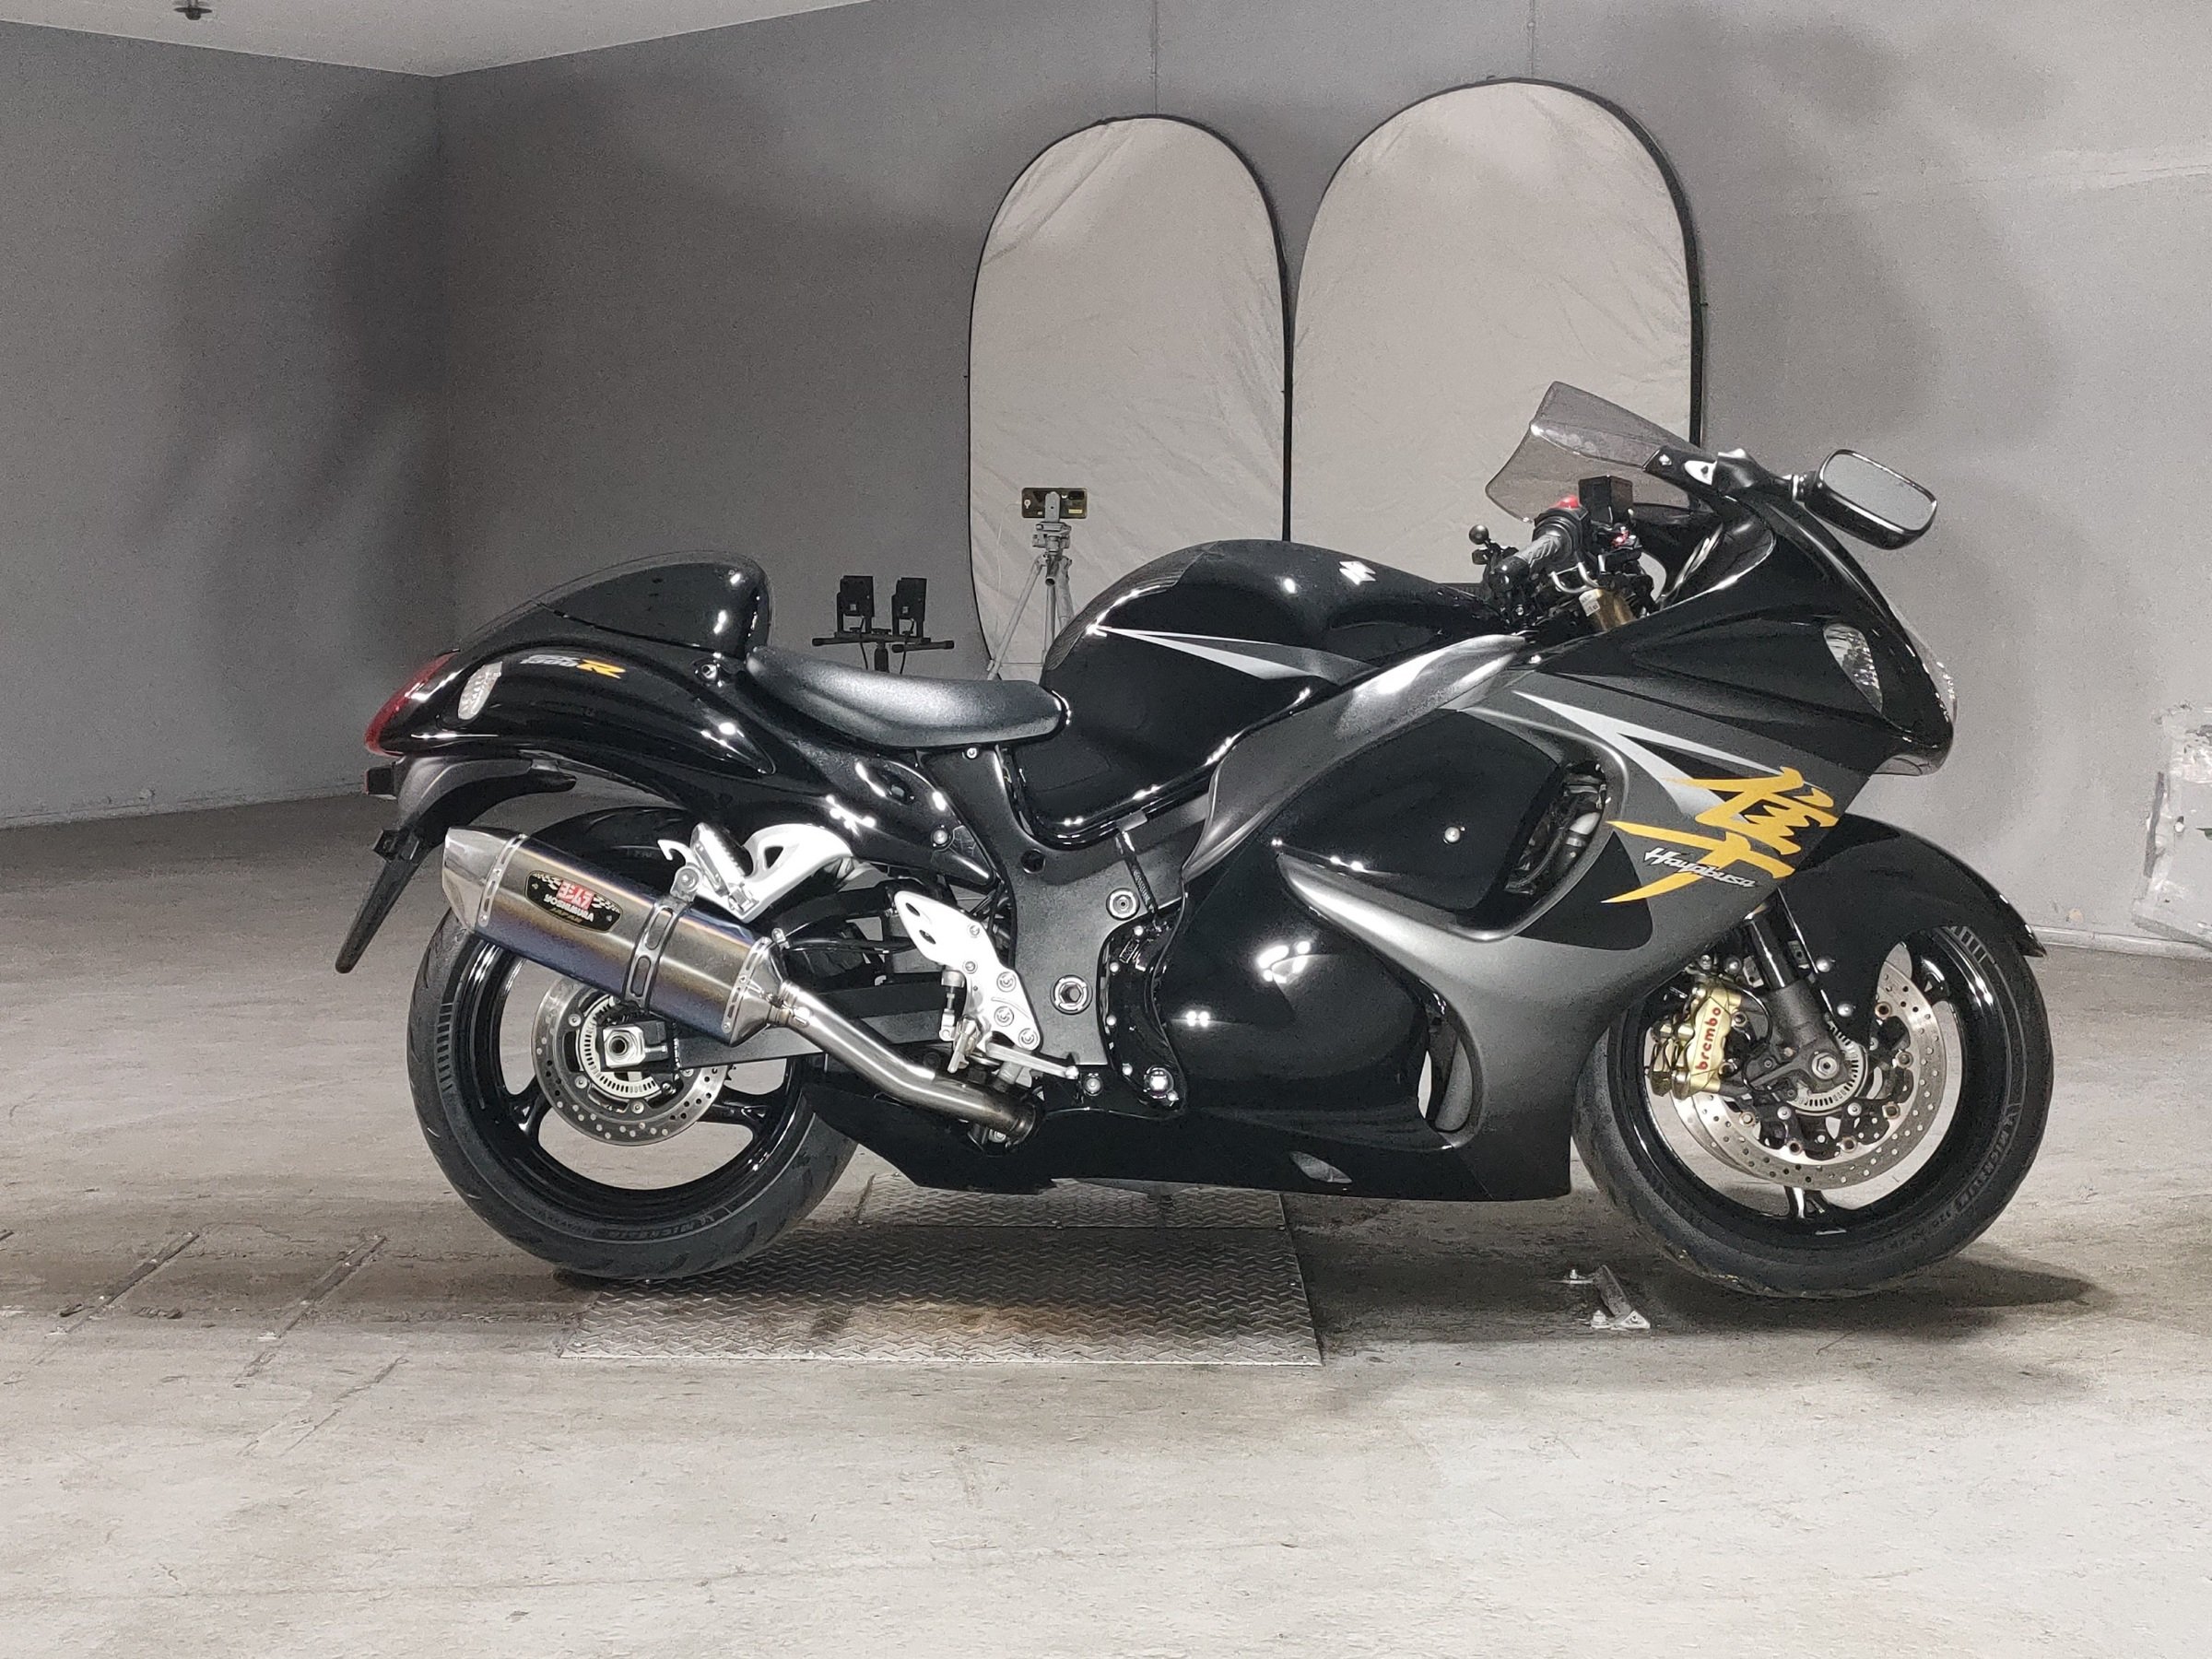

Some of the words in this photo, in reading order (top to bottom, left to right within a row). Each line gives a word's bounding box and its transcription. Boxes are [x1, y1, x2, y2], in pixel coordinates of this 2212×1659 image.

[1600, 766, 1839, 904] 隼
[1642, 847, 1756, 888] Hayabusa
[544, 893, 594, 922] YOSHIMURA
[1695, 1006, 1722, 1070] brembo
